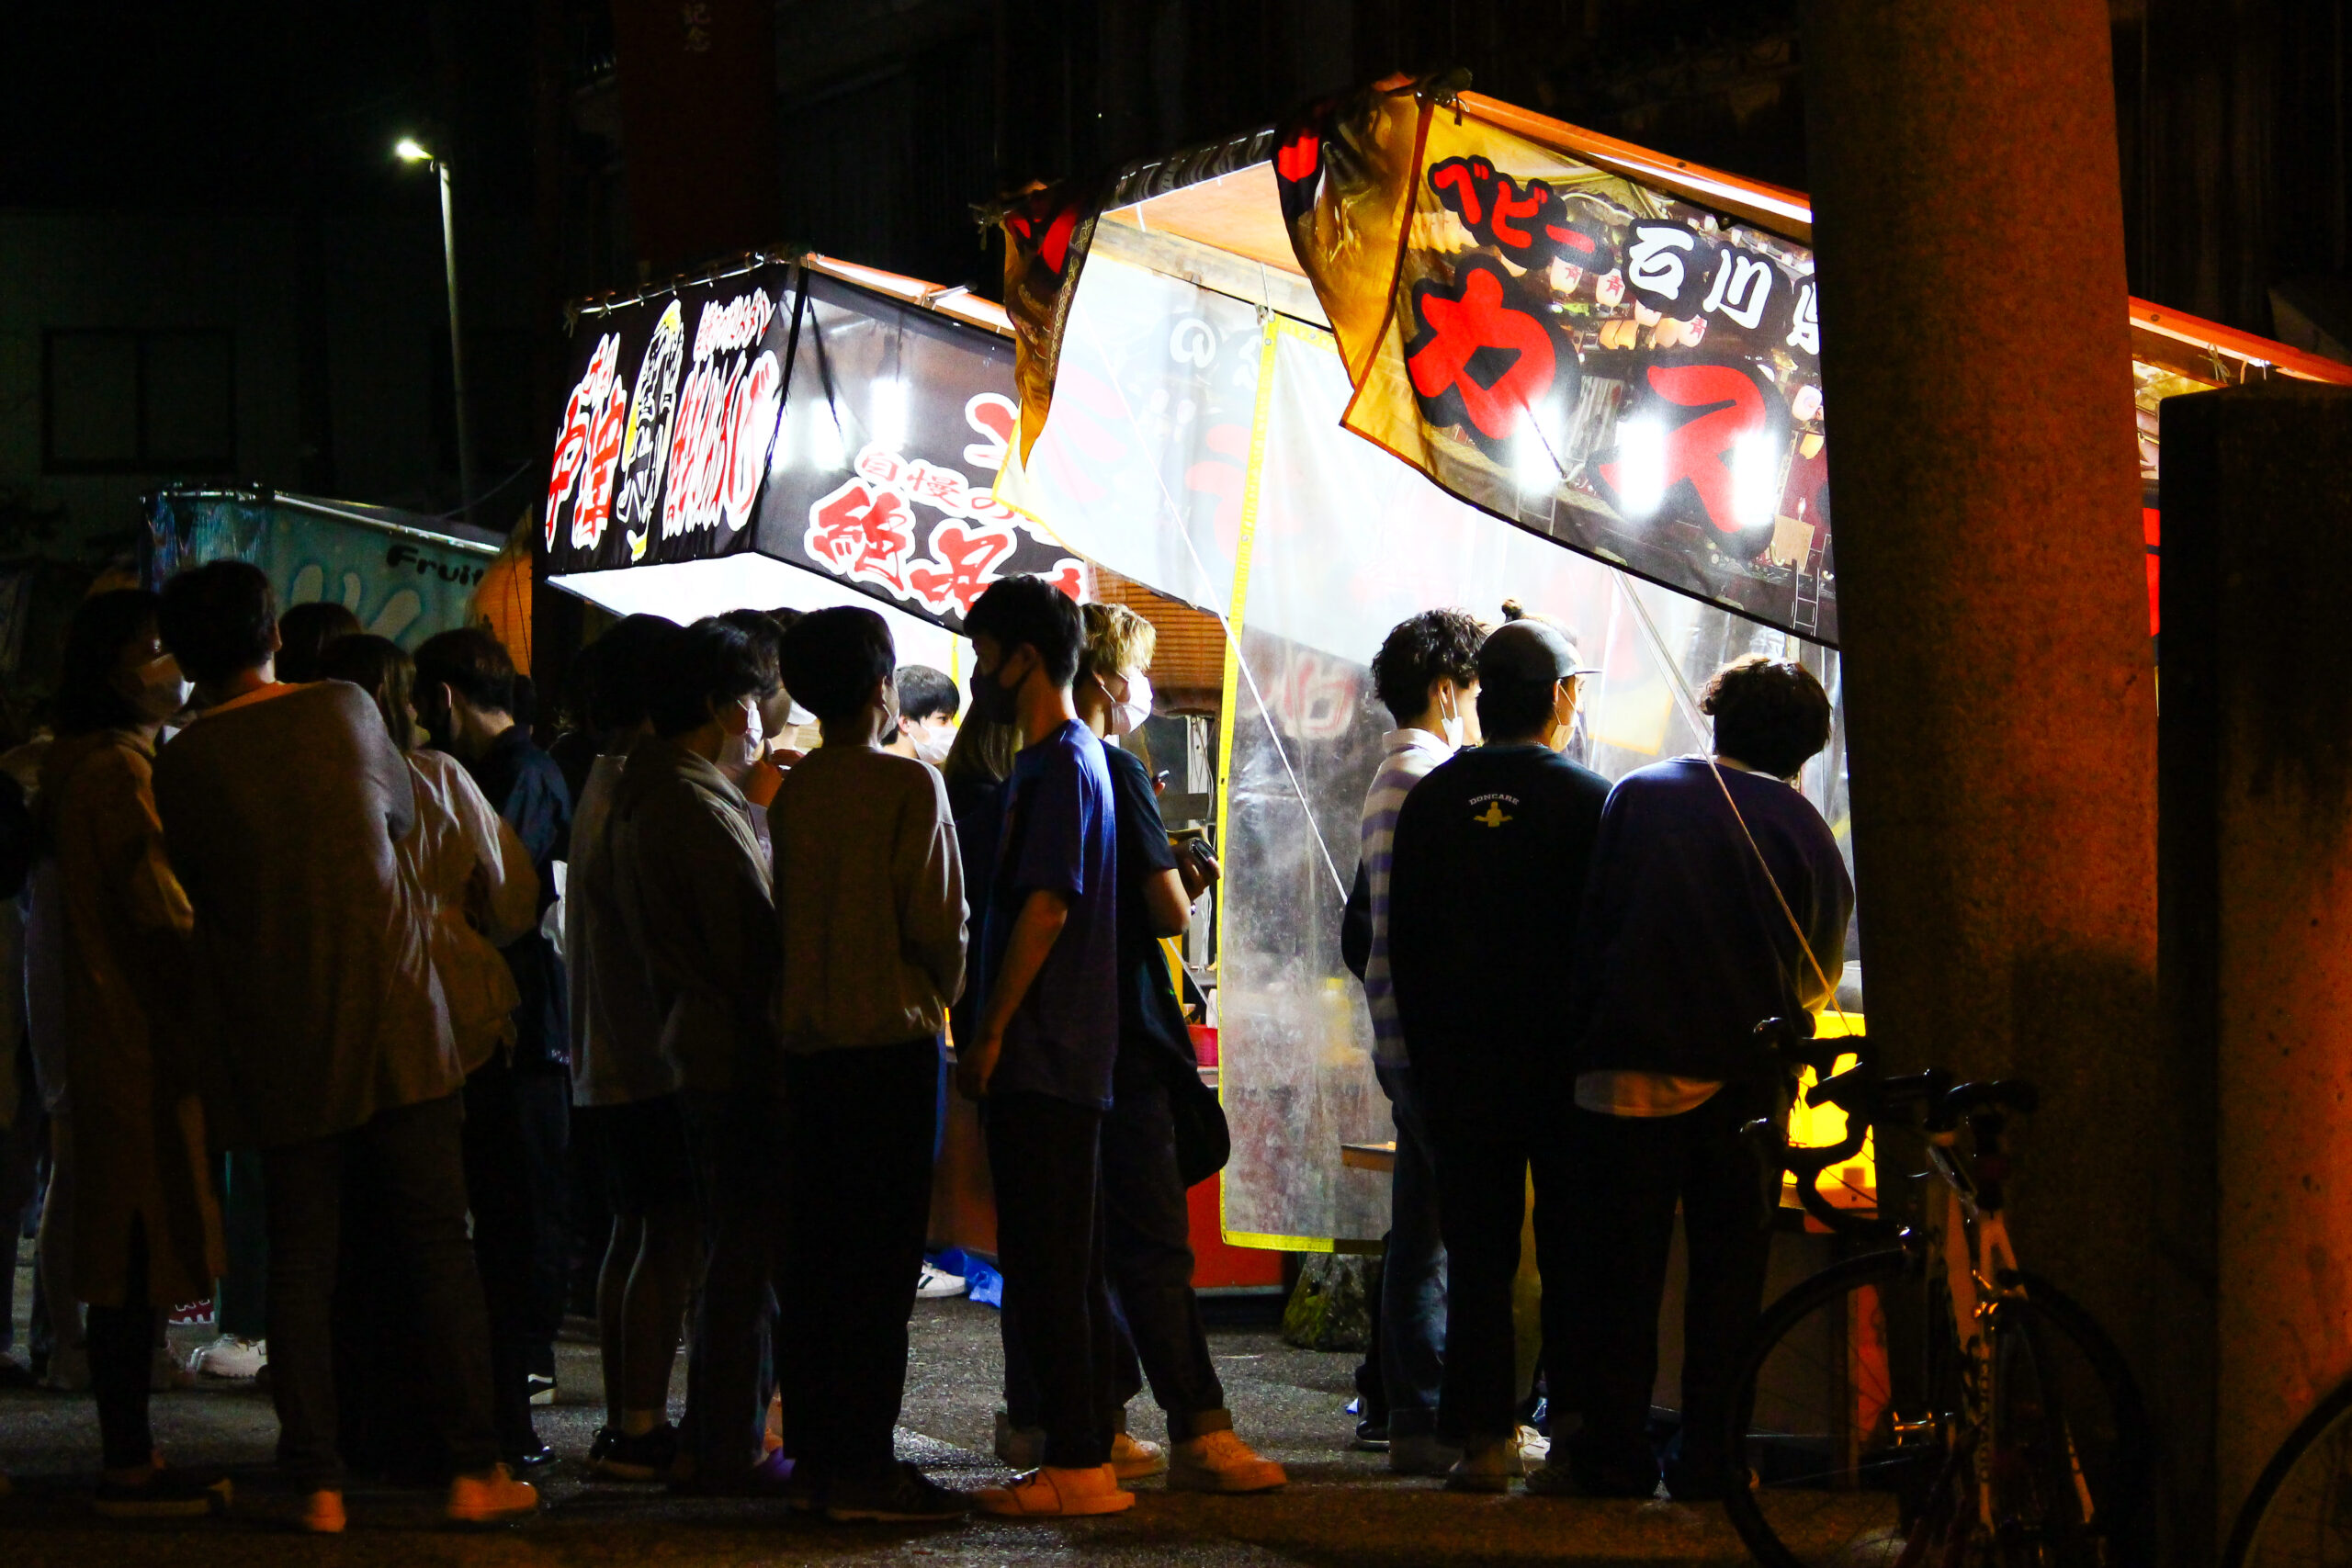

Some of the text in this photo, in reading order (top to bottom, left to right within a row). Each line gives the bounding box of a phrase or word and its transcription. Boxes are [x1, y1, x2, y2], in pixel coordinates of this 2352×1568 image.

[1433, 162, 1597, 254] ベビー
[855, 443, 1062, 547] 自慢の
[805, 478, 1085, 617] 絶品
